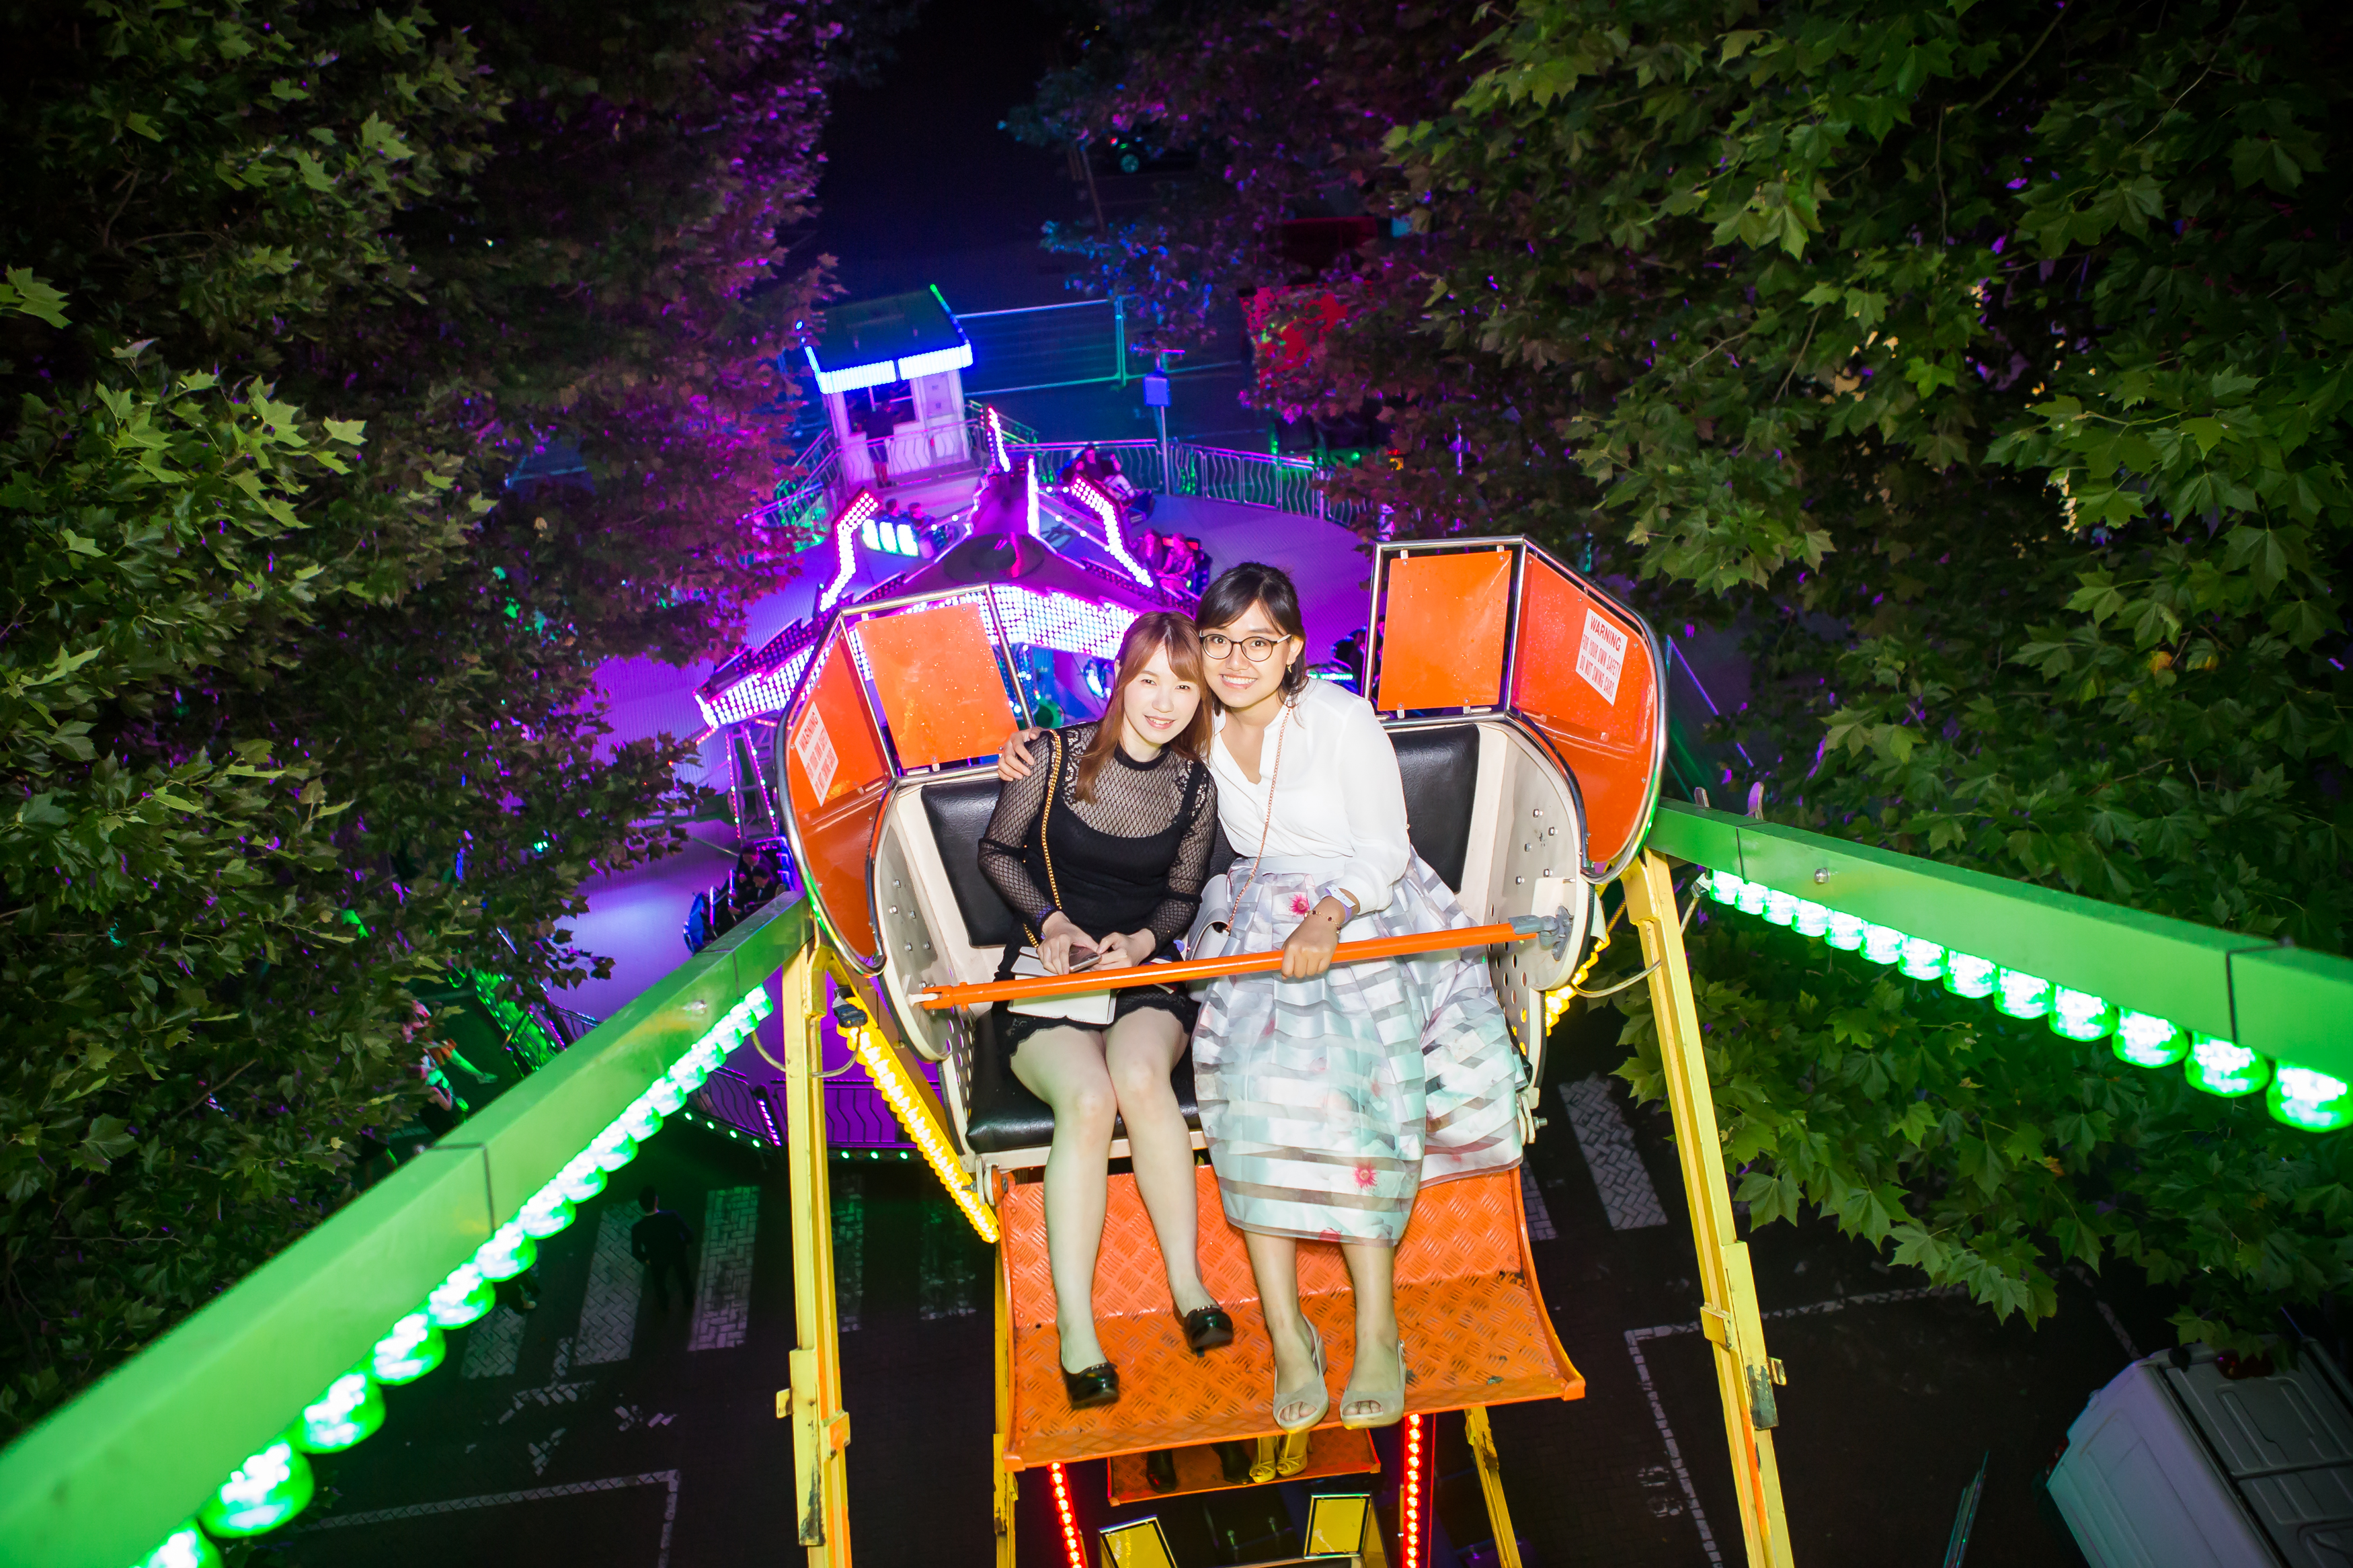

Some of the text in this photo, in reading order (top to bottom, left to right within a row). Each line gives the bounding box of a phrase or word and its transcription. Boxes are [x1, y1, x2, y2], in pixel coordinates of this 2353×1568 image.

[1591, 616, 1621, 652] WARNING
[1581, 634, 1589, 652] FOR
[1606, 655, 1622, 679] SAFETY
[1603, 675, 1614, 698] CARS
[799, 711, 819, 753] WARNING
